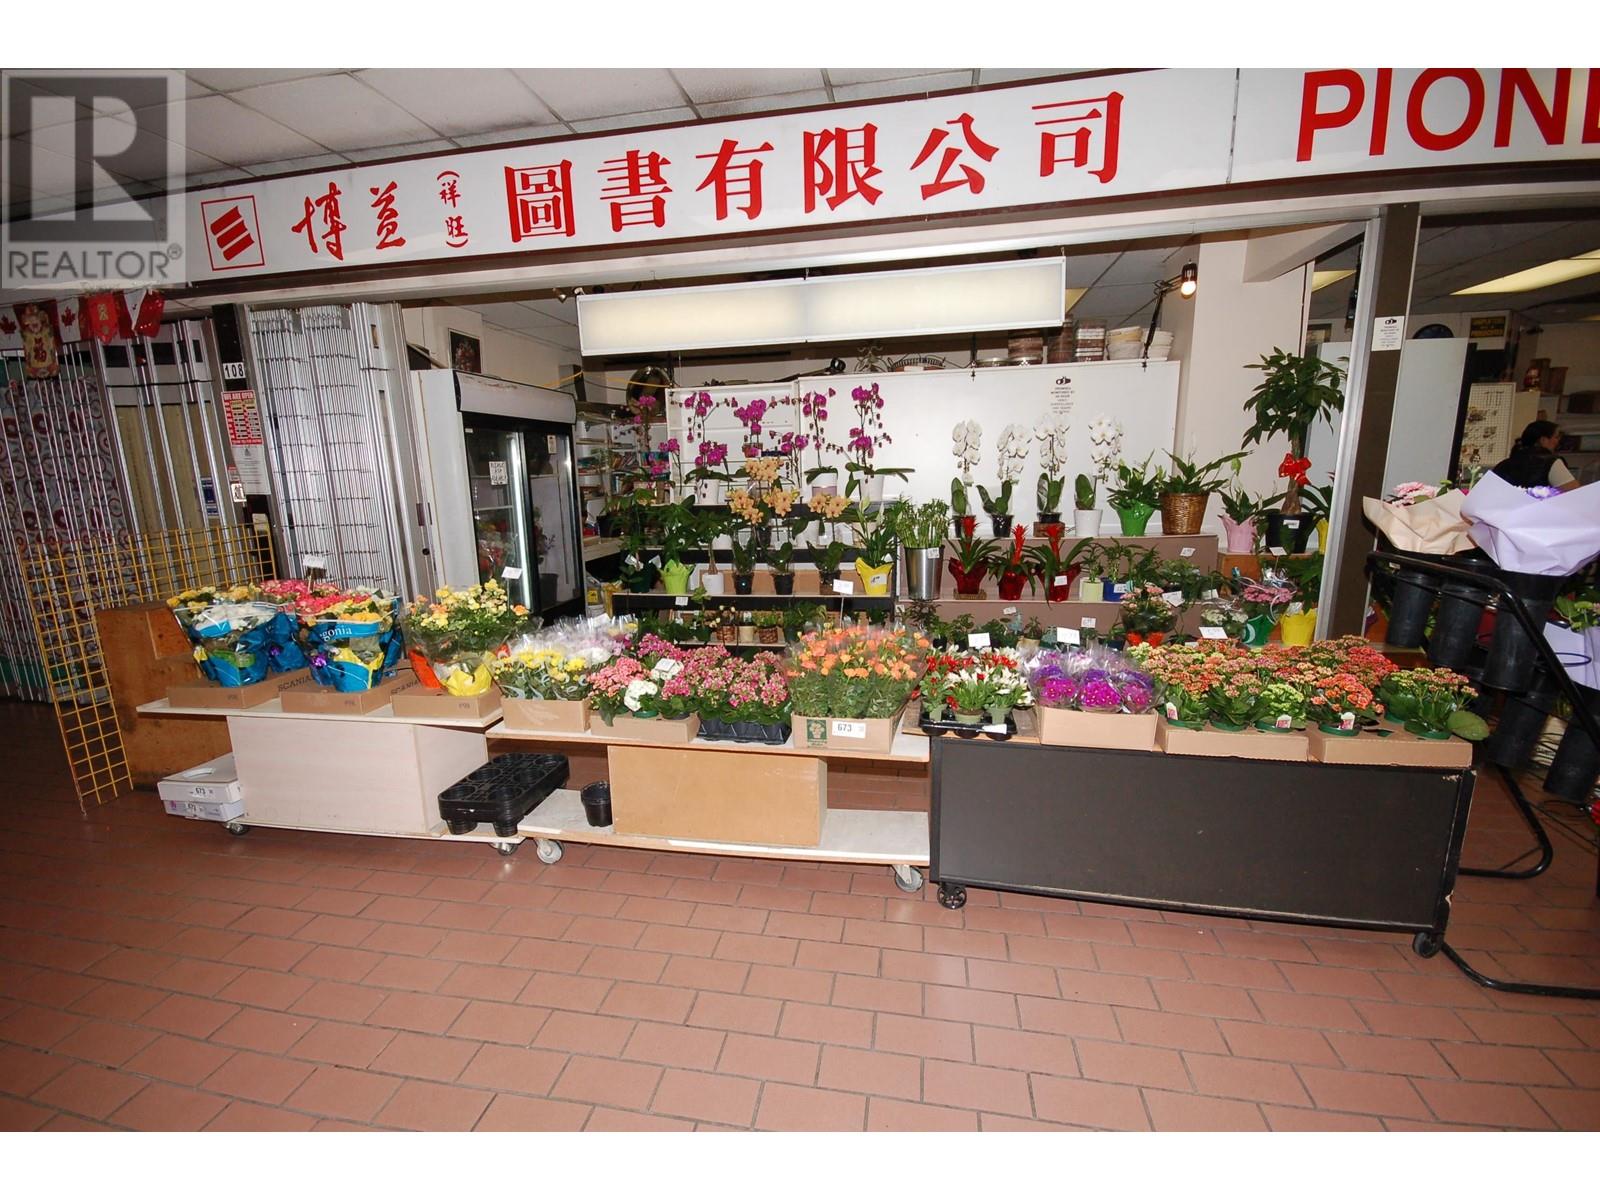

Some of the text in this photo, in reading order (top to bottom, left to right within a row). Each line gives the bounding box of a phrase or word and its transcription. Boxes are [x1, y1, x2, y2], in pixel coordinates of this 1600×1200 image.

[292, 182, 406, 260] 博益
[504, 91, 1124, 243] 圖書有限公司
[225, 363, 244, 378] 108
[232, 392, 241, 400] ARE
[241, 391, 253, 399] OPEN
[837, 722, 853, 733] 673
